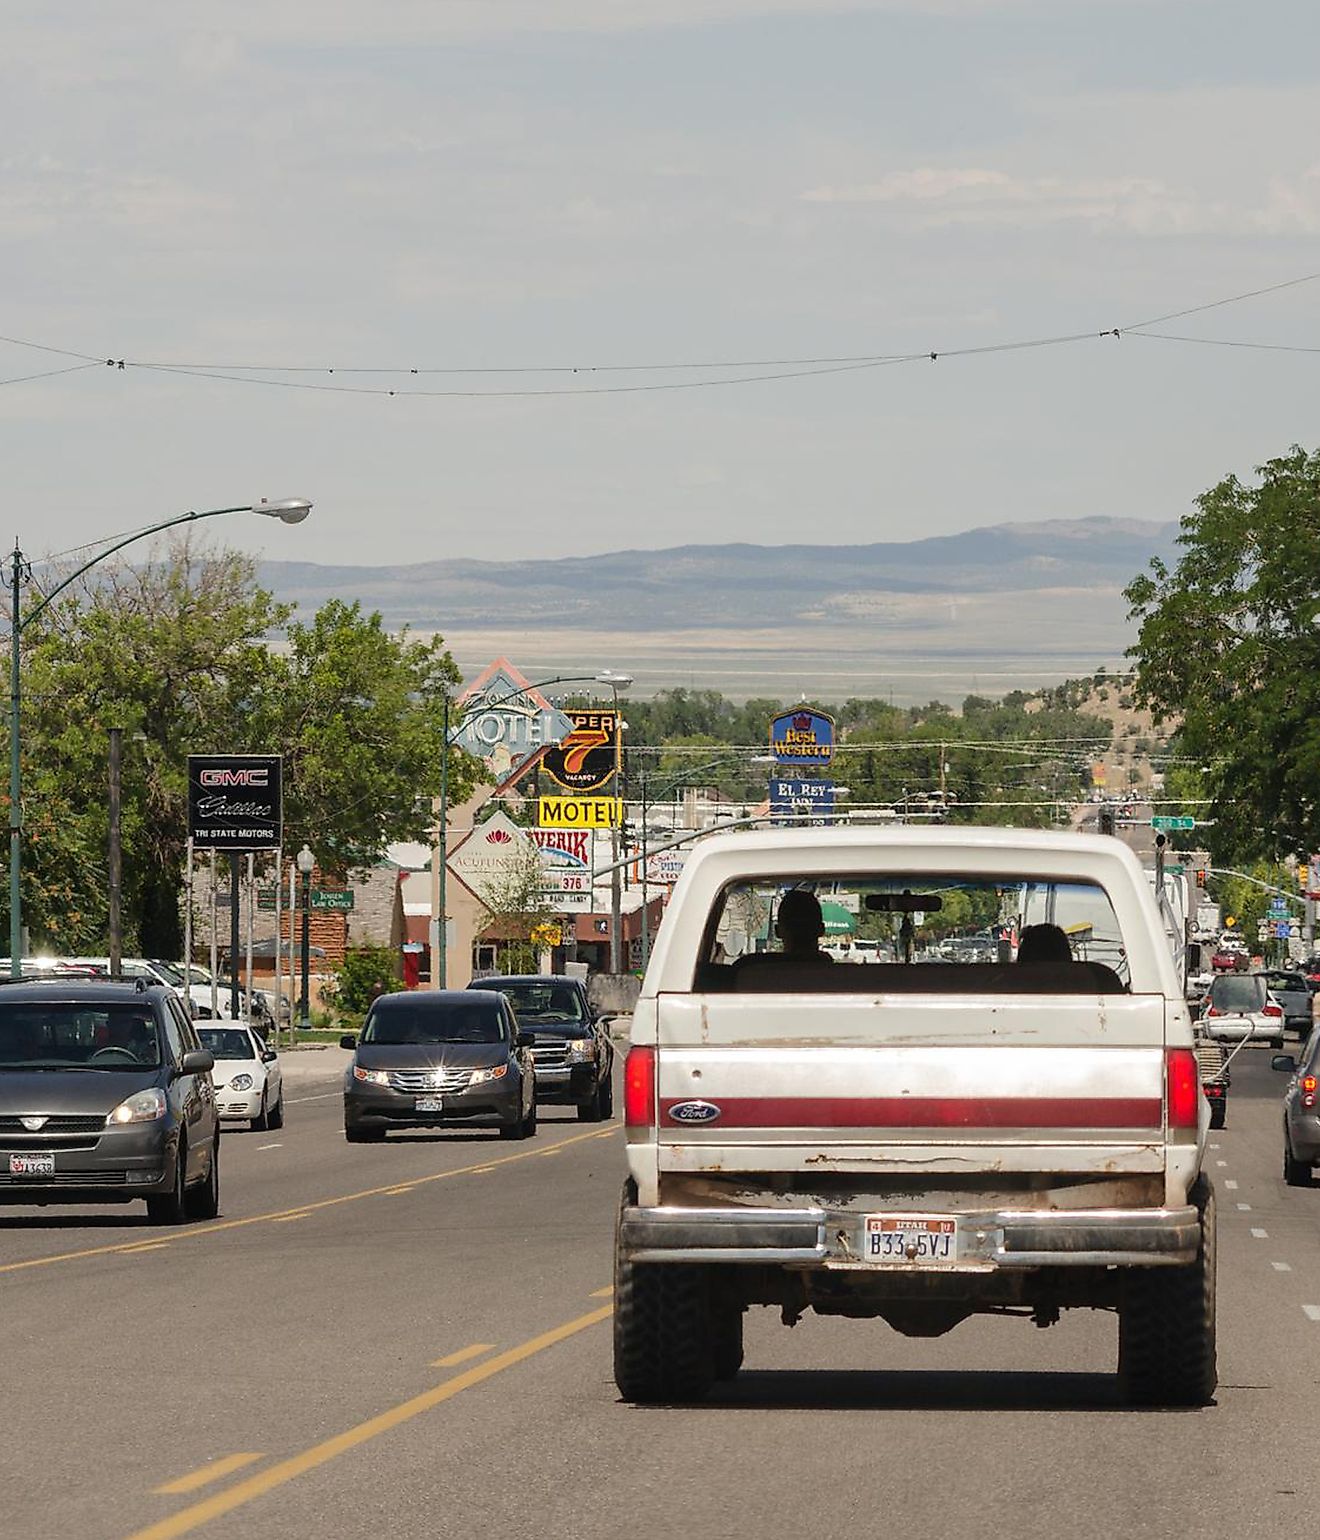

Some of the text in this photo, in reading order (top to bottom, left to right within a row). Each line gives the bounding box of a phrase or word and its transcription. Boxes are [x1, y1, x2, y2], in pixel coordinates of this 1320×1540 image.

[785, 727, 817, 744] Best
[559, 730, 609, 773] 7
[774, 740, 832, 757] Western
[200, 769, 269, 786] GMC
[778, 783, 826, 797] EL REY
[196, 795, 272, 818] Cadillac
[543, 801, 616, 822] MOTEL
[194, 829, 274, 838] TRI STATE MOTORS
[562, 877, 582, 890] 376
[680, 1105, 708, 1118] Ford
[871, 1233, 951, 1257] B33 5VJ
